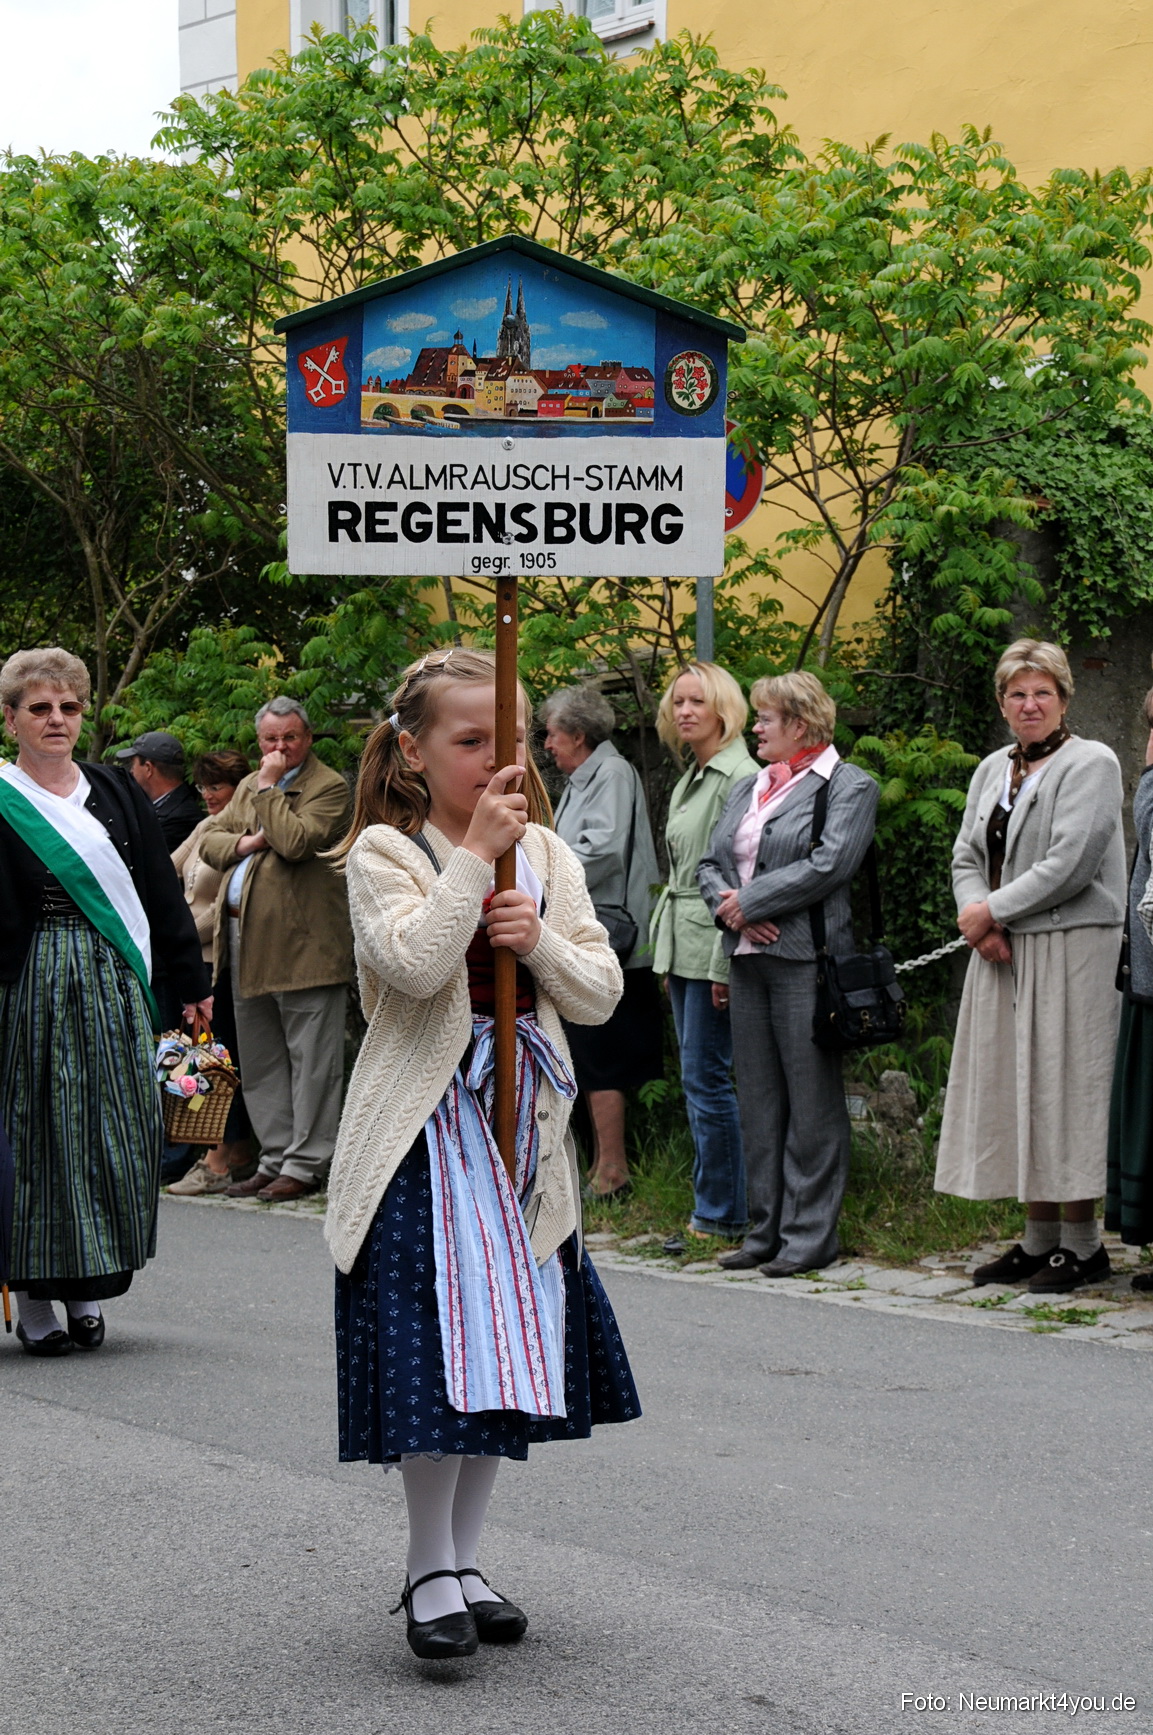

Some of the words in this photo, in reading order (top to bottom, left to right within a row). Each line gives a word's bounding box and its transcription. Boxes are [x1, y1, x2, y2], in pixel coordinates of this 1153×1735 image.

[327, 500, 684, 546] REGENSBURG
[471, 555, 511, 575] gegr.
[519, 552, 557, 569] 1905
